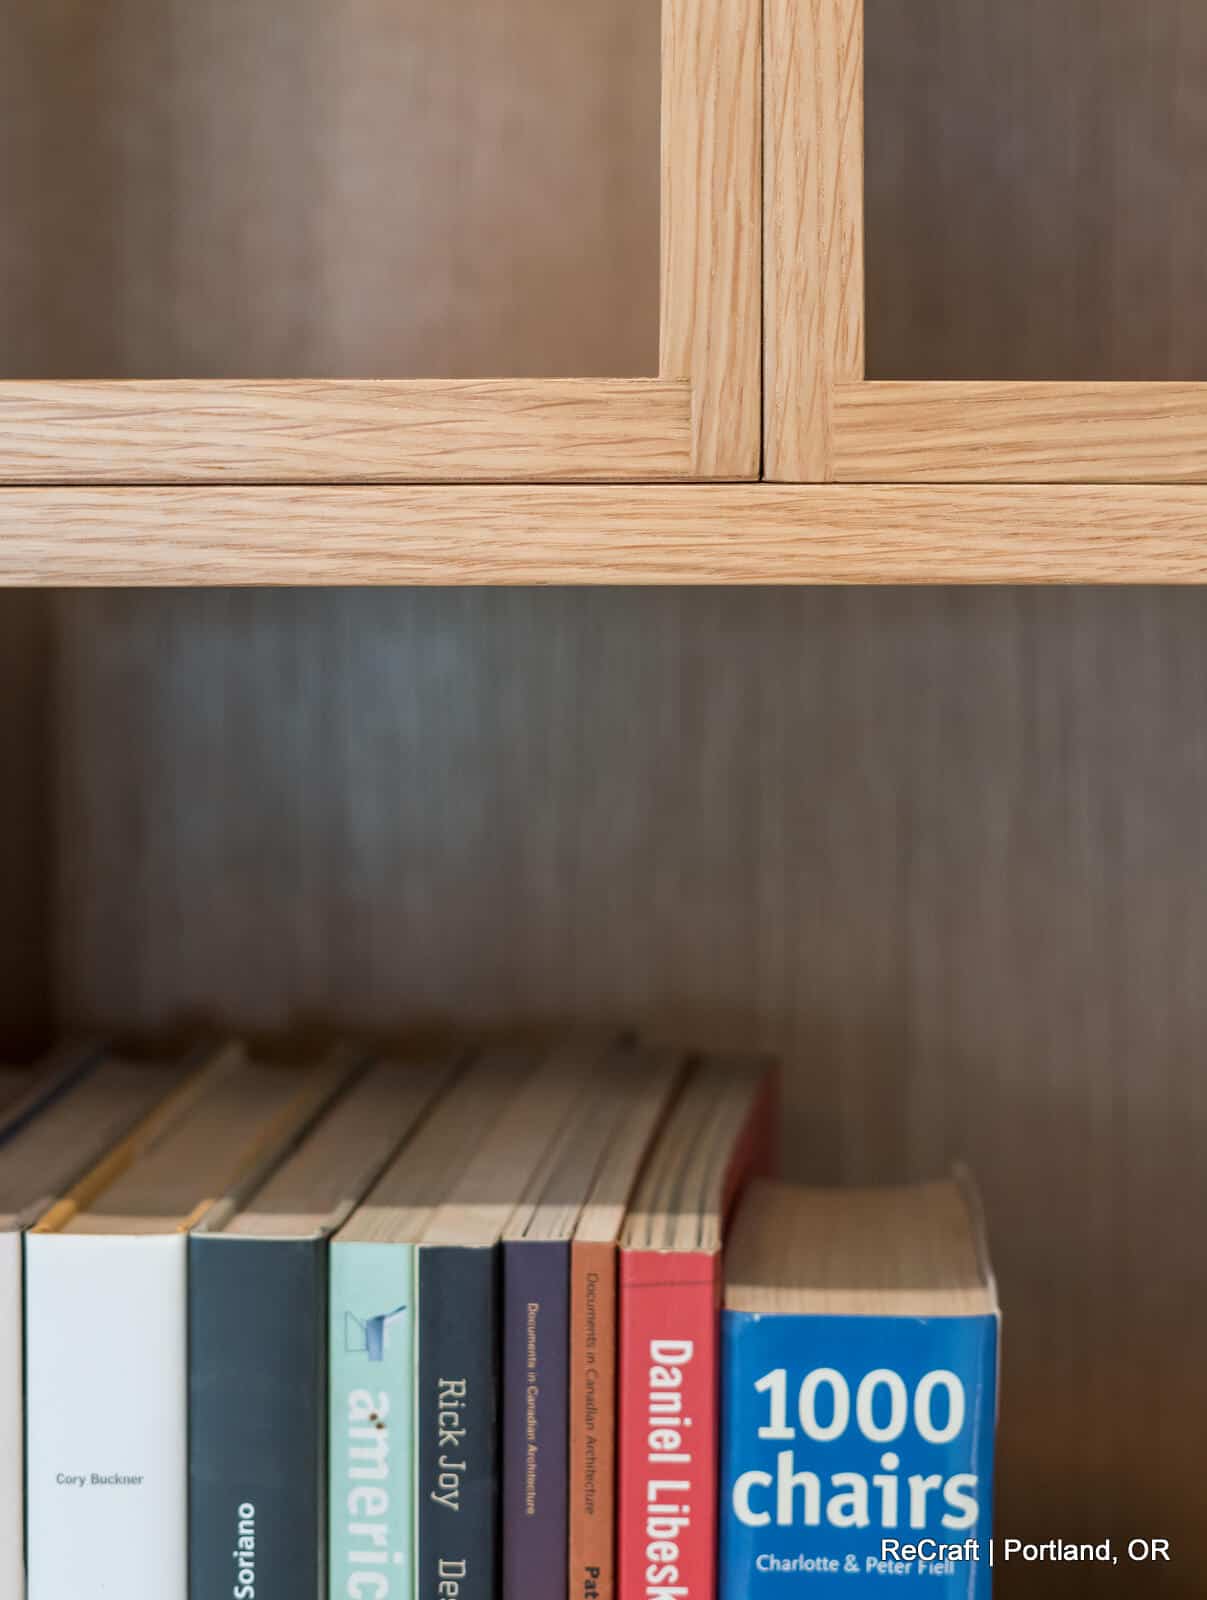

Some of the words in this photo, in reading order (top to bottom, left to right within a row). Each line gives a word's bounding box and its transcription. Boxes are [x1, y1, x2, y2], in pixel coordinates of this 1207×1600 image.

[438, 1378, 467, 1447] Rick
[527, 1385, 538, 1440] Canadian
[585, 1368, 599, 1430] Canadian
[648, 1339, 694, 1464] Daniel
[753, 1367, 966, 1445] 1000
[56, 1473, 87, 1487] Cory
[91, 1473, 144, 1486] Buckner
[431, 1455, 467, 1512] Joy
[527, 1443, 538, 1515] Architecture
[584, 1435, 598, 1515] Architecture
[732, 1450, 979, 1530] chairs
[233, 1502, 256, 1600] Soriano
[437, 1558, 467, 1600] De
[755, 1553, 840, 1573] Charlotte
[844, 1553, 860, 1574] &
[865, 1555, 911, 1576] Peter
